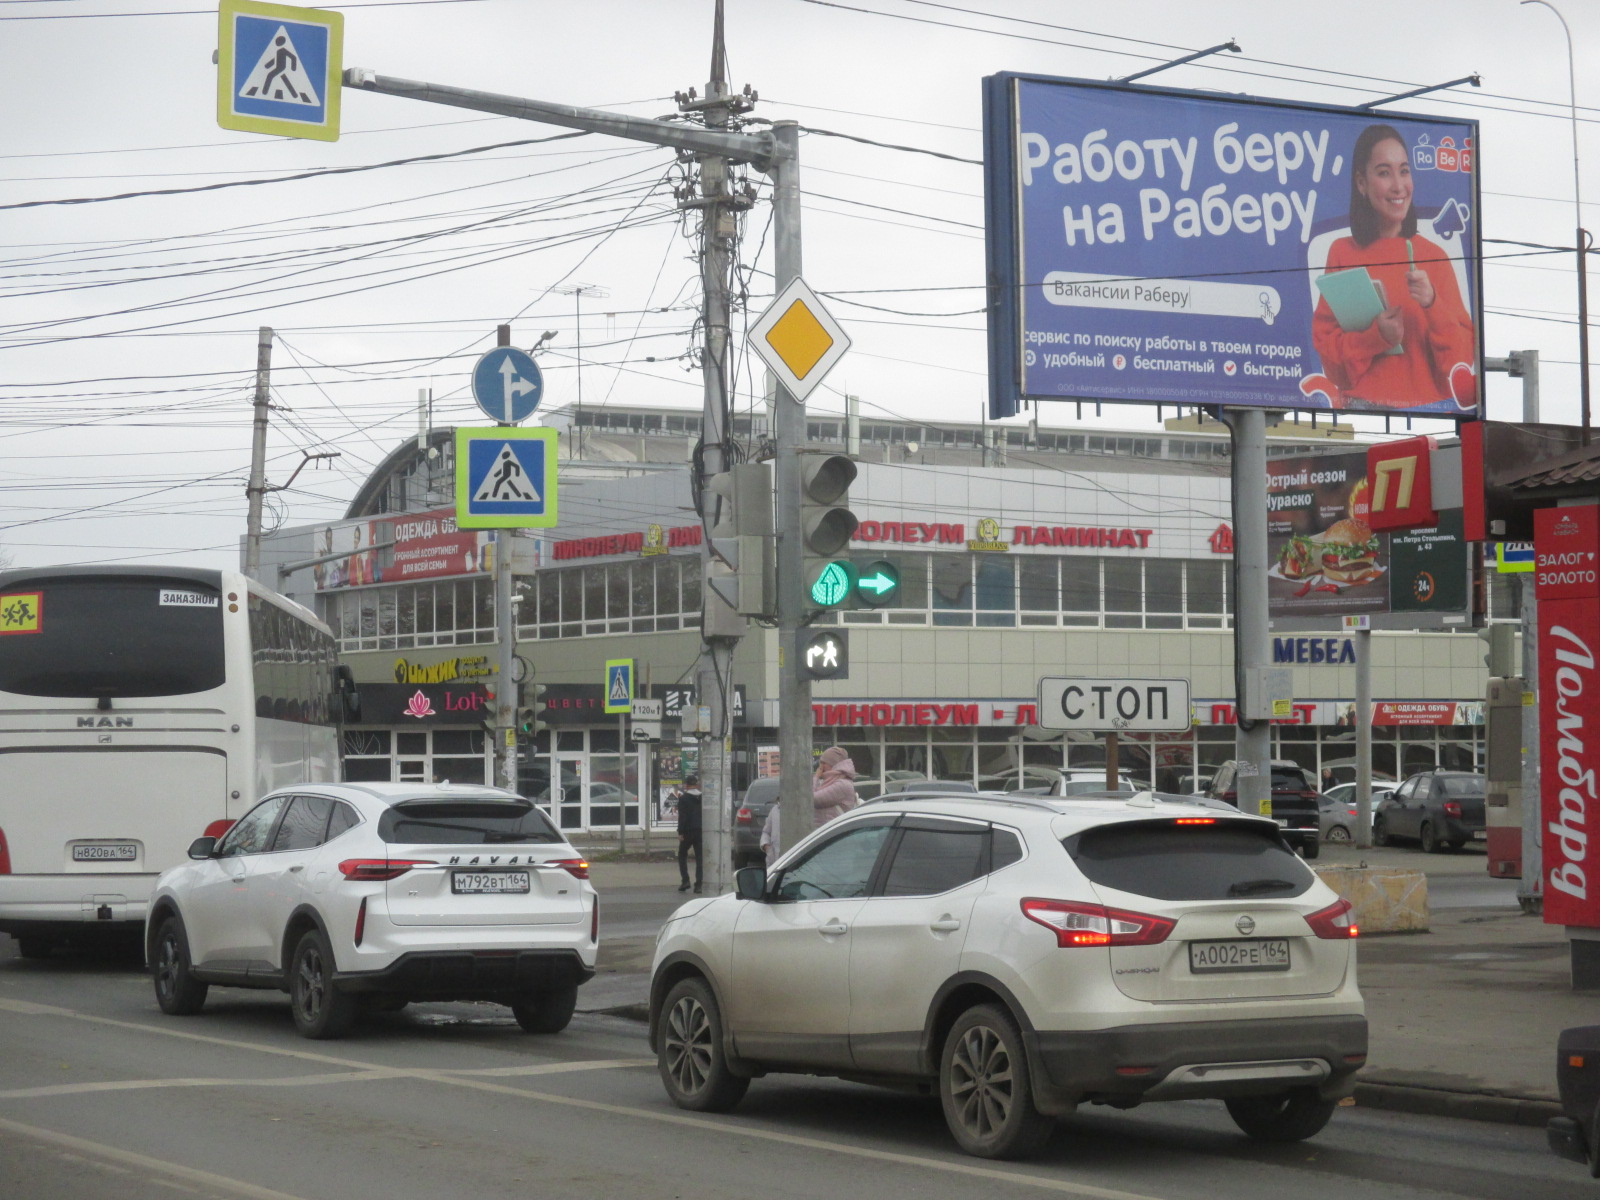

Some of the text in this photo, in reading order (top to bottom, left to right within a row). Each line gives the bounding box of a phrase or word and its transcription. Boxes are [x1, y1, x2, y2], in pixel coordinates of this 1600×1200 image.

[1020, 121, 1344, 192] Работу беру,
[1417, 151, 1433, 164] Ra
[1440, 151, 1456, 166] Be
[1063, 182, 1318, 247] на Раберу
[1053, 279, 1190, 309] Вакансии Раберу
[1073, 332, 1092, 345] по
[1094, 333, 1142, 351] поиску
[1145, 334, 1196, 353] работы
[1199, 340, 1208, 353] в
[1210, 340, 1252, 355] твоем
[1255, 343, 1303, 359] городе
[1042, 351, 1106, 370] удобный
[1133, 354, 1216, 374] бесплатный
[1243, 361, 1303, 380] быстрый
[1265, 469, 1347, 490] Острый сезон
[395, 519, 438, 543] ОДЕЖДА
[1013, 525, 1153, 549] ЛАМИНАТ
[1403, 535, 1421, 543] Петра
[1410, 527, 1438, 535] проспект
[552, 531, 645, 561] ЛИНОЛЕУМ
[1538, 552, 1584, 567] ЗАЛОГ
[1538, 570, 1596, 585] ЗОЛОТО
[637, 705, 656, 716] 120м
[1061, 684, 1168, 721] СТОП
[1397, 704, 1426, 712] ОДЕЖДА
[1427, 703, 1449, 712] ОБУВЬ
[77, 716, 133, 728] MAN
[1550, 625, 1598, 900] Ломбард
[77, 846, 133, 857] Н820ВА 164
[449, 856, 536, 865] HAVAL
[457, 874, 527, 888] М792ВТ 164
[1199, 942, 1285, 966] А002РЕ 164
